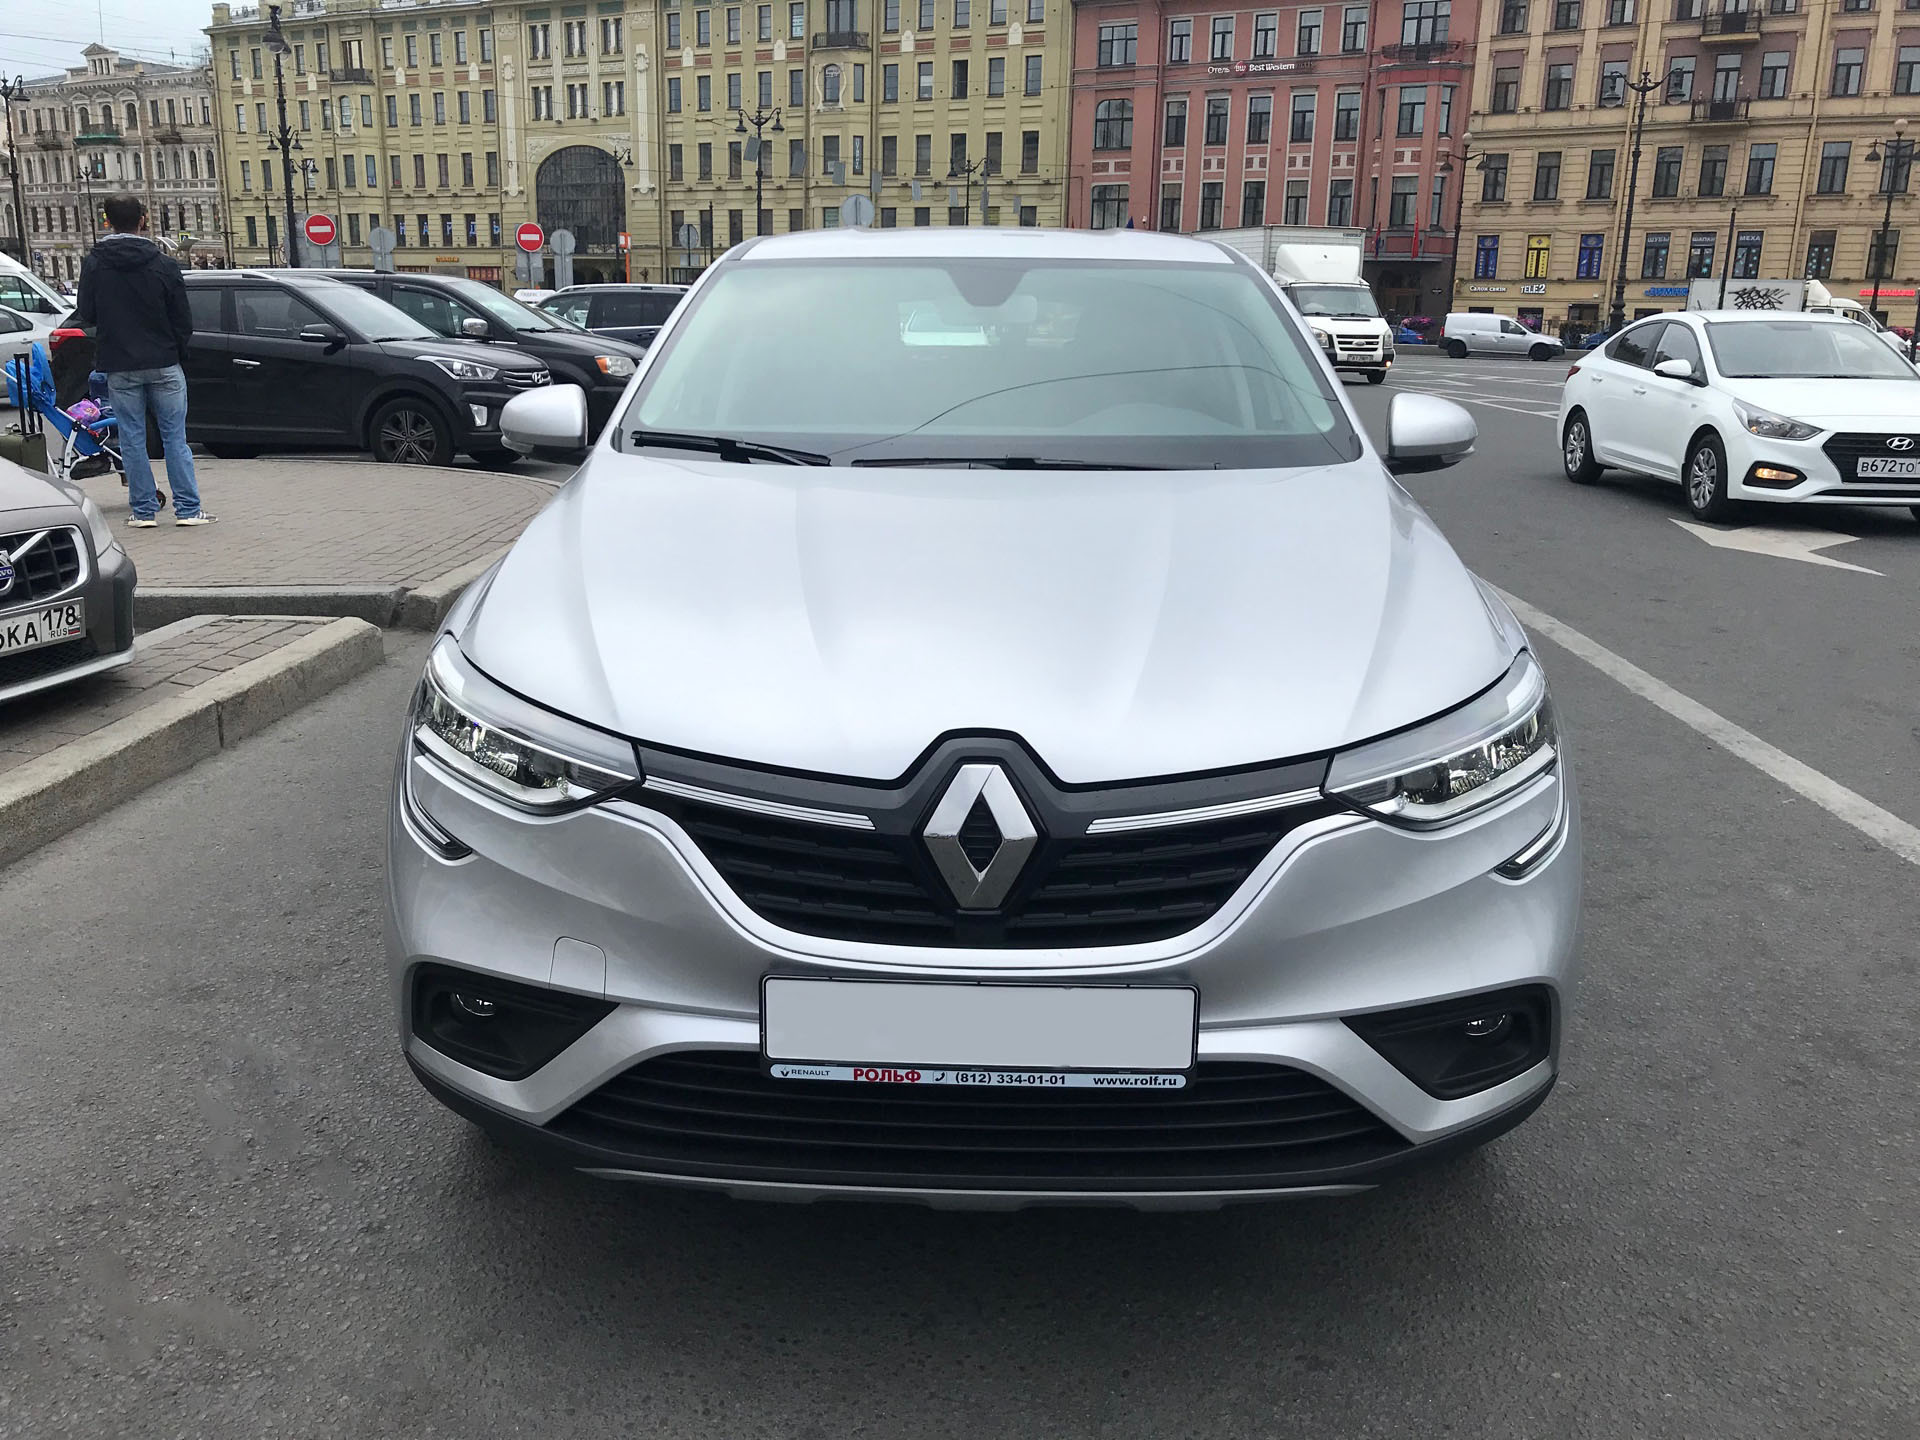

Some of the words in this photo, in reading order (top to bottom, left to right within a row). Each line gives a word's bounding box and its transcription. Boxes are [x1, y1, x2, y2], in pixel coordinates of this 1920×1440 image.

[1249, 63, 1265, 72] Best
[1265, 63, 1295, 71] Western
[1521, 284, 1546, 294] TELE2
[50, 627, 68, 639] RUS
[791, 1069, 830, 1077] RENAULT
[853, 1067, 921, 1083] РОЛЬФ
[955, 1071, 992, 1084] (812)
[996, 1073, 1066, 1085] 334-01-01
[1093, 1075, 1177, 1087] www.rolf.ru
